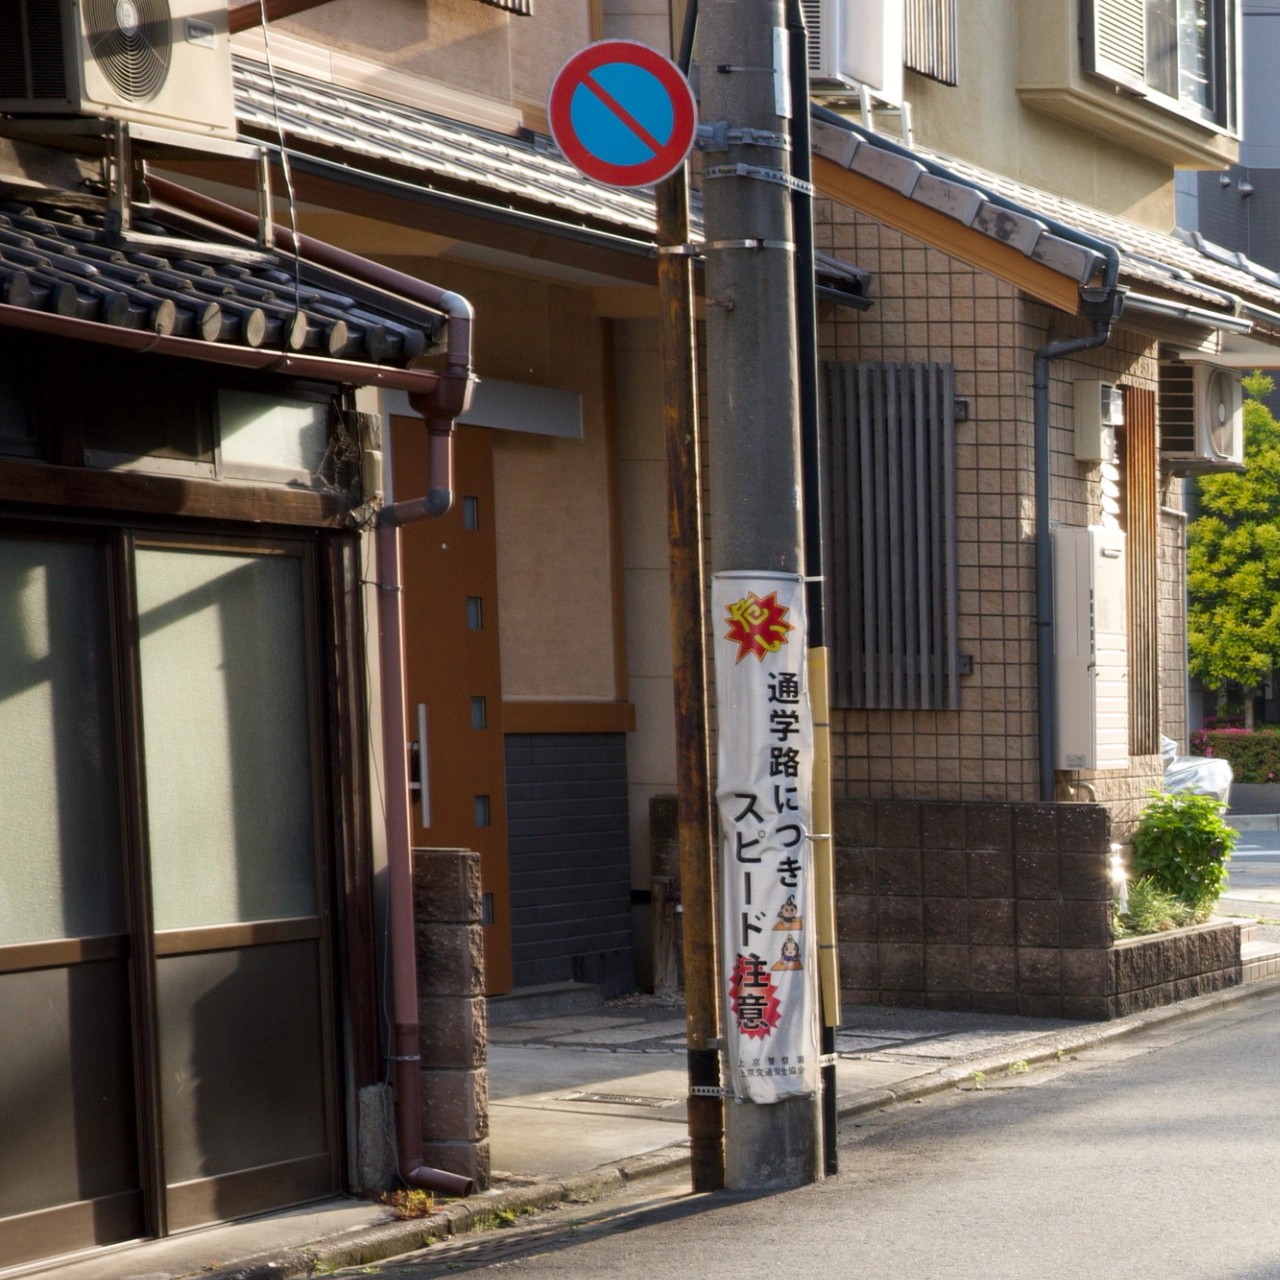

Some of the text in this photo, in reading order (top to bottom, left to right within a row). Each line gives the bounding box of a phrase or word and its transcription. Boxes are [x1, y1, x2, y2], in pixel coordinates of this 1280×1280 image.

[767, 671, 803, 888] 通学路につき
[734, 792, 769, 1029] スピード注意
